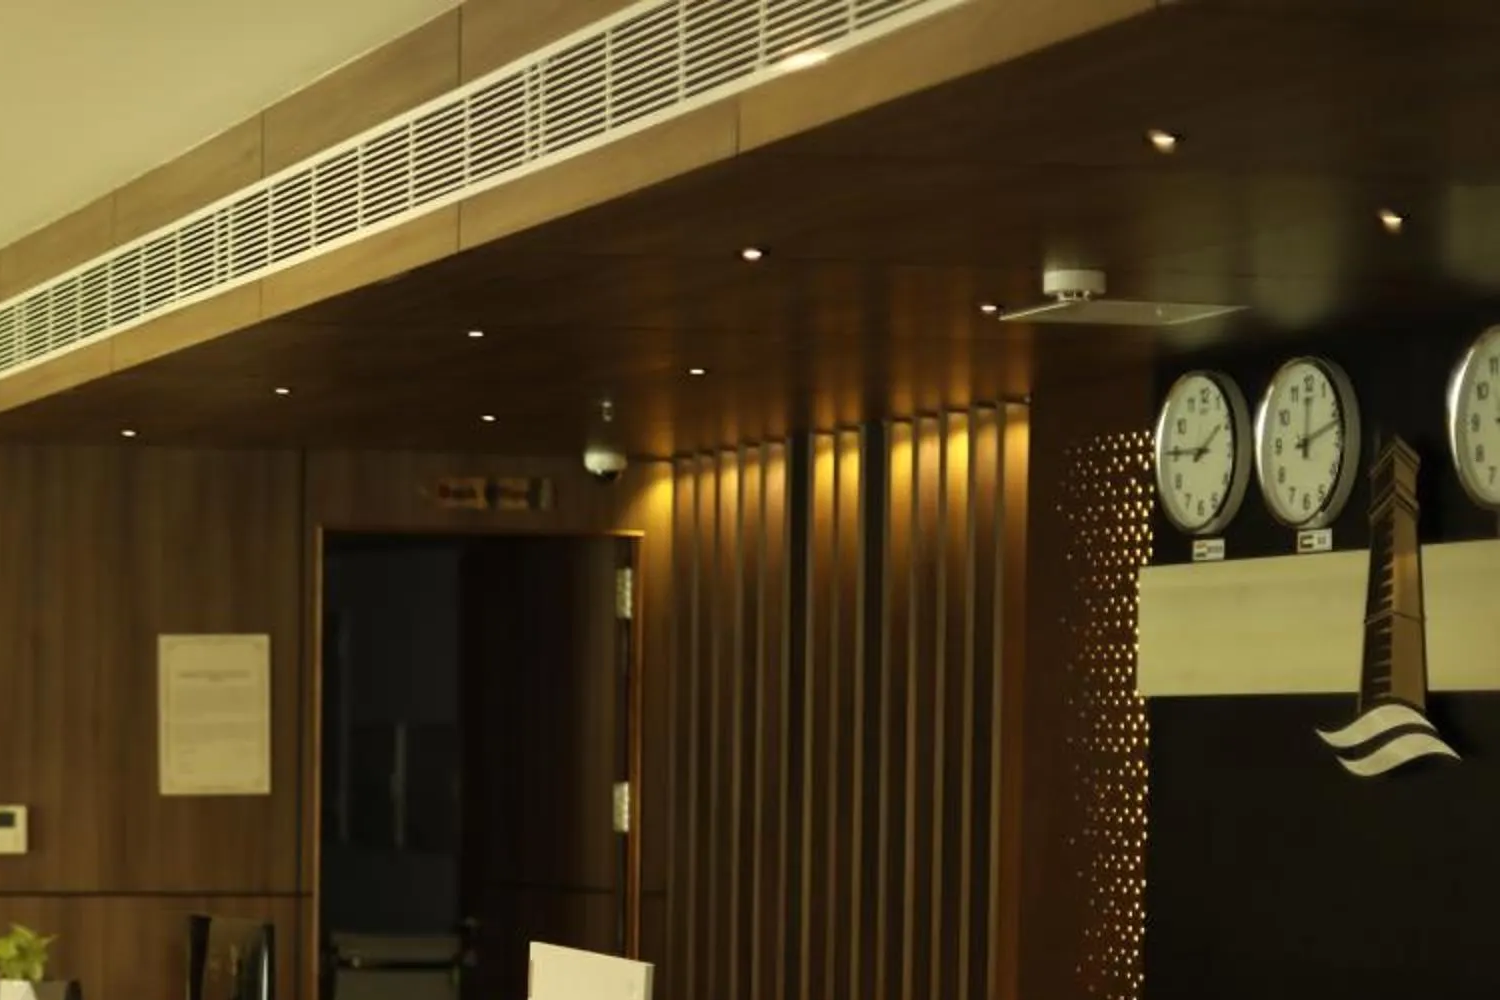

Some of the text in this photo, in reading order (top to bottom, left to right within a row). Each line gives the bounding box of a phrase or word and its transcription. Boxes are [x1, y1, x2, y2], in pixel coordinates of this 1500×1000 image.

[1489, 357, 1498, 375] 11
[1304, 374, 1314, 392] 12
[1477, 381, 1489, 400] 10
[1201, 386, 1210, 403] 12
[1291, 385, 1299, 402] 11
[1187, 397, 1195, 412] 11
[1279, 408, 1290, 426] 10
[1471, 413, 1480, 432] 9
[1177, 418, 1186, 434] 10
[1275, 438, 1282, 455] 9
[1475, 444, 1484, 462] 8
[1175, 472, 1182, 489] 8
[1278, 465, 1285, 483] 8
[1488, 466, 1497, 484] 7
[1185, 493, 1192, 509] 7
[1289, 486, 1296, 504] 7
[1318, 484, 1325, 501] 5
[1198, 499, 1204, 516] 6
[1303, 493, 1311, 510] 6
